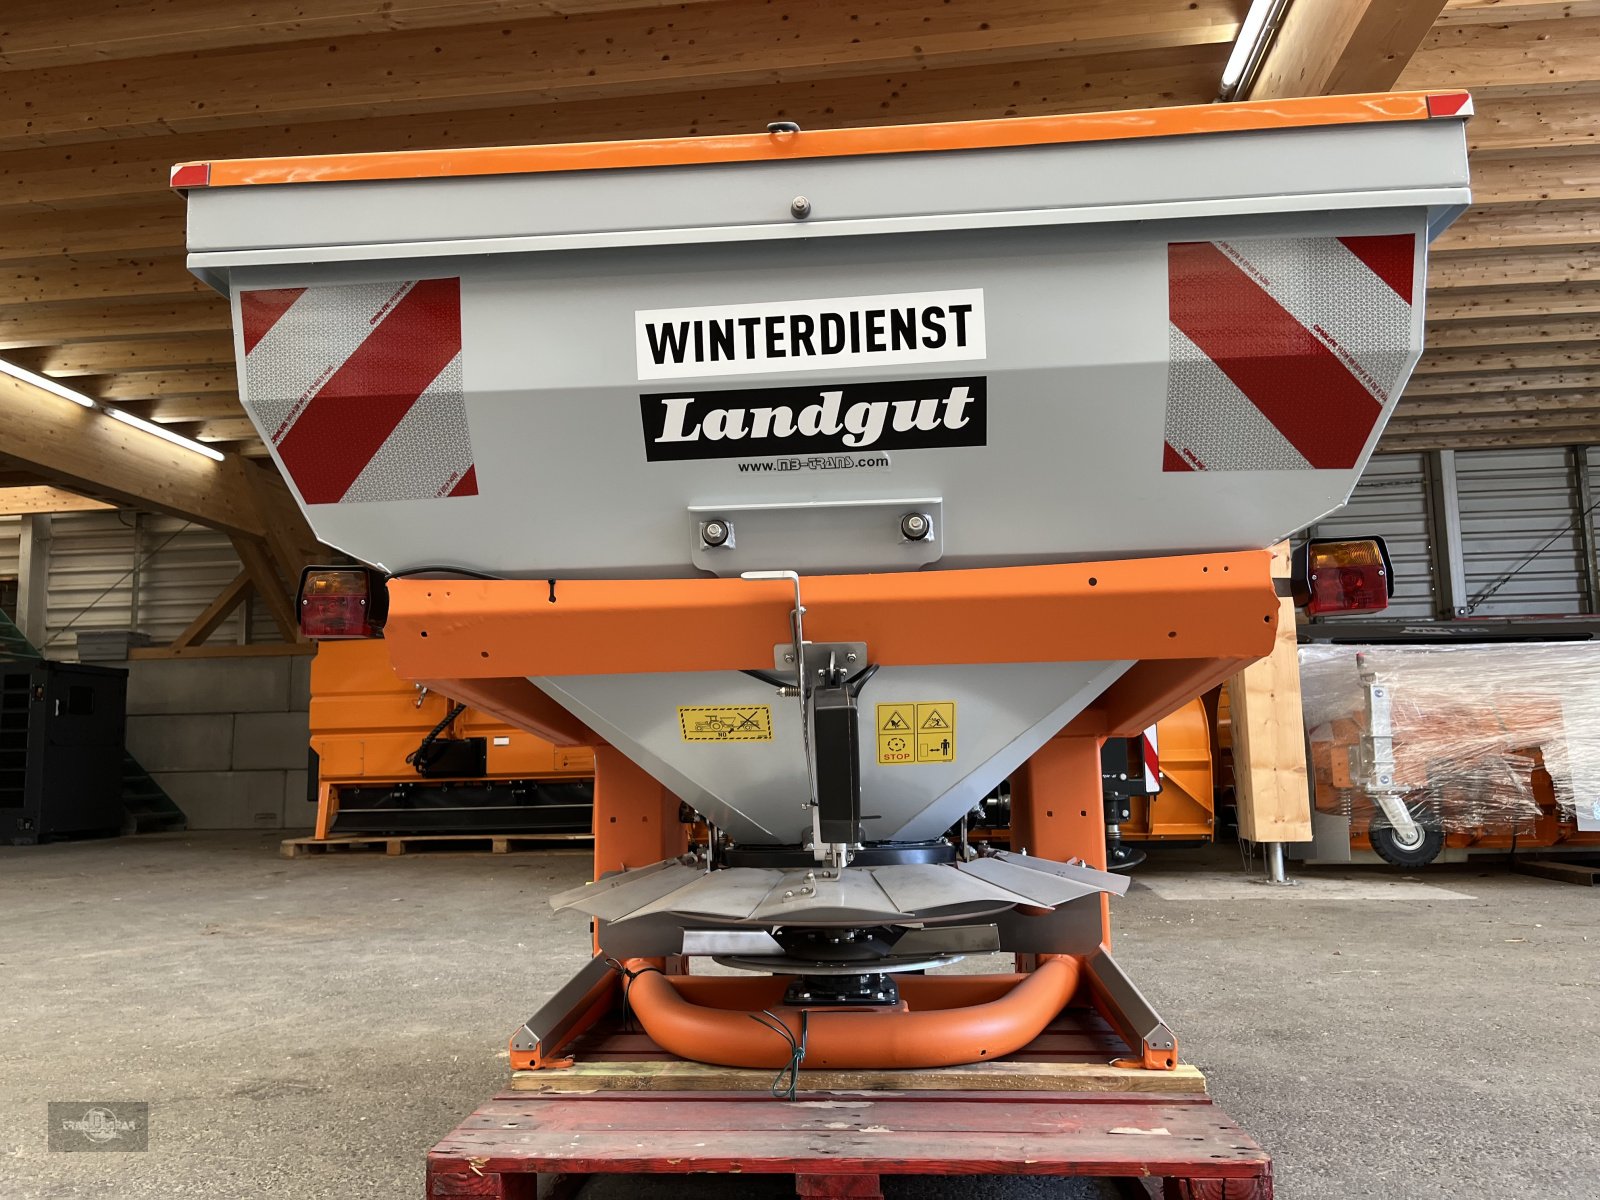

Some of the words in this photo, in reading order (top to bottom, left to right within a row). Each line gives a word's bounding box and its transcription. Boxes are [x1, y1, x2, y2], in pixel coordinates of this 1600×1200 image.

[645, 304, 973, 365] WINTERDIENST
[655, 386, 976, 448] Landgut
[883, 753, 911, 761] STOP
